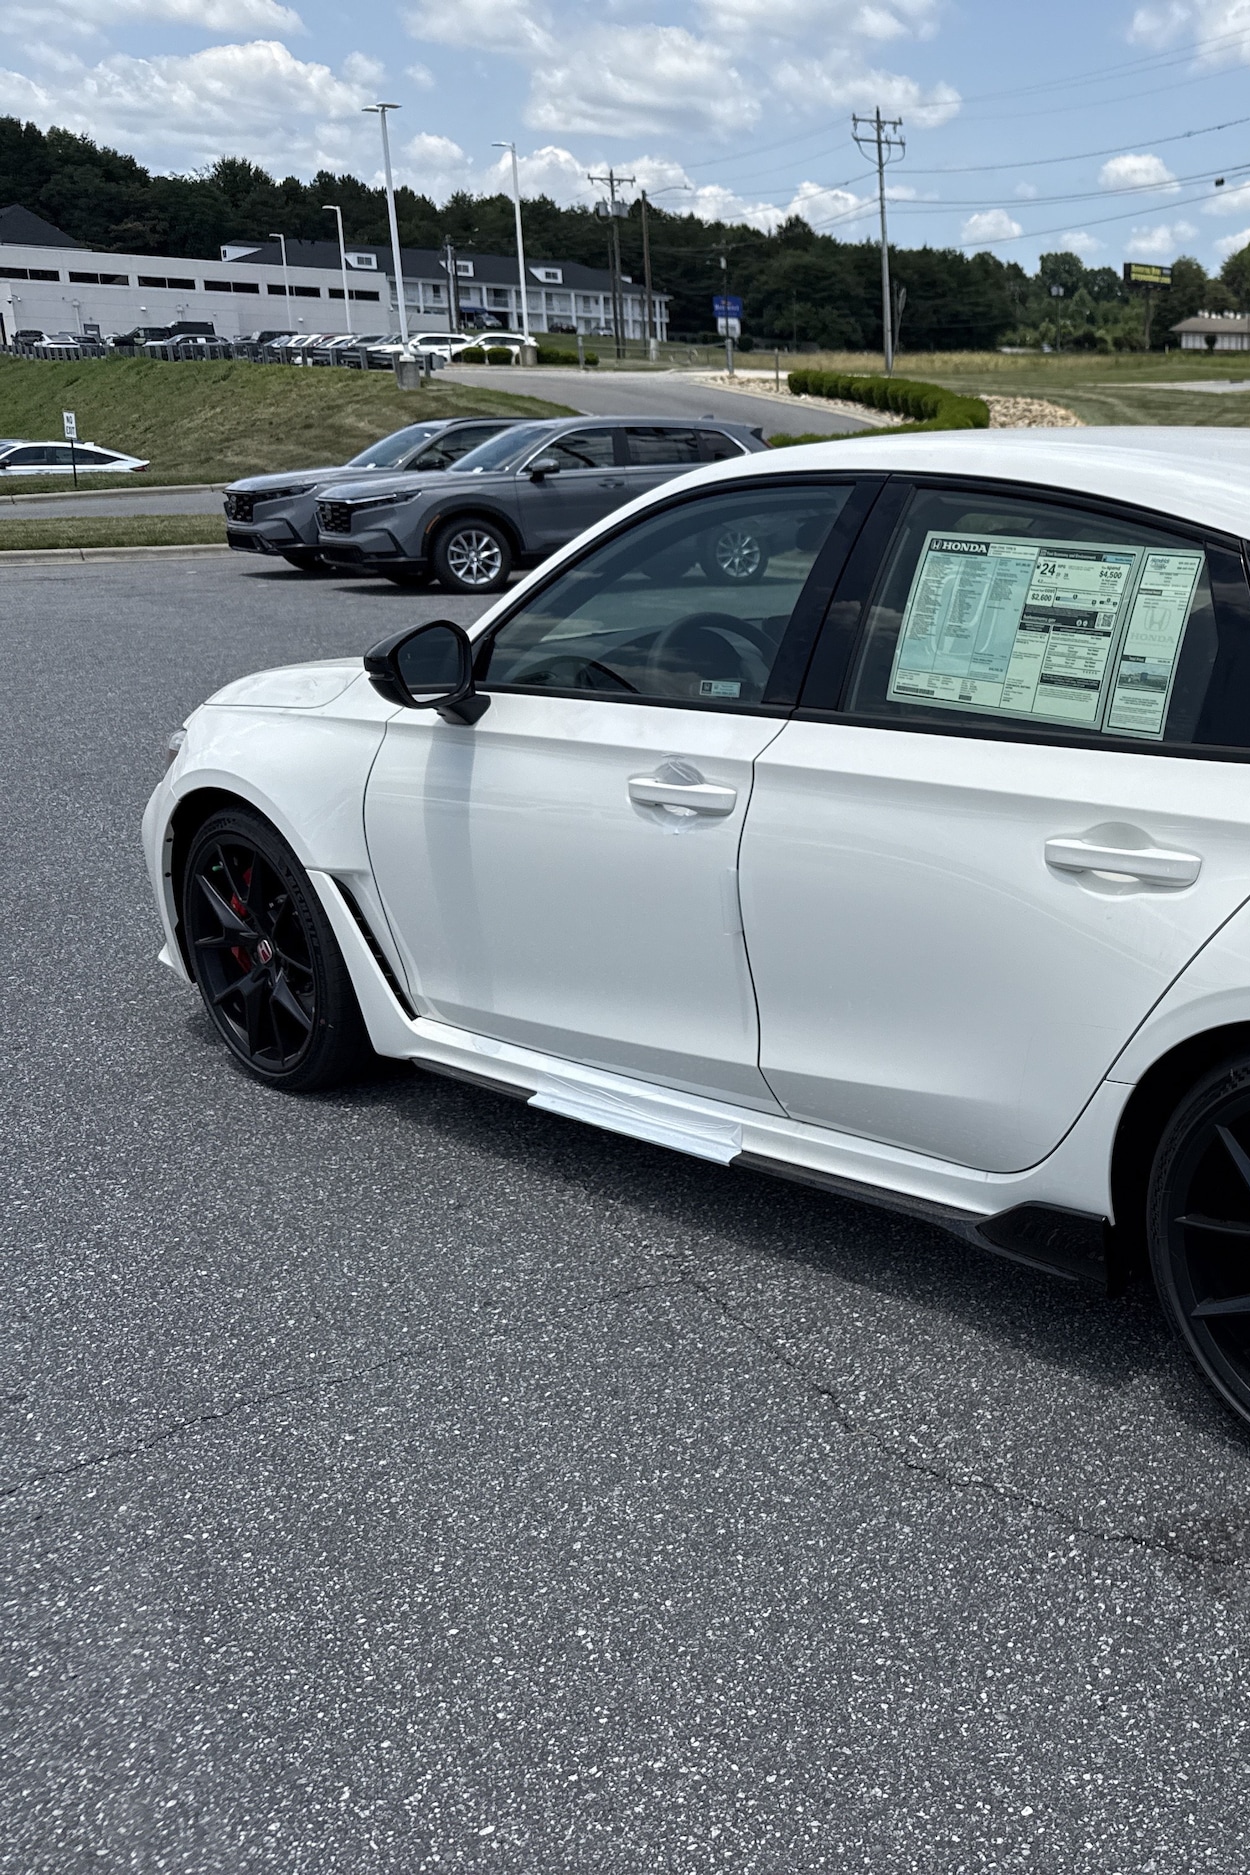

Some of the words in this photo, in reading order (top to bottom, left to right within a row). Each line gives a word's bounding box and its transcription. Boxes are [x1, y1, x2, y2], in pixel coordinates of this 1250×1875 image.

[942, 541, 987, 553] HONDA
[1040, 563, 1056, 576] 24
[1099, 571, 1122, 580] $4,500
[1031, 593, 1052, 602] $2,600
